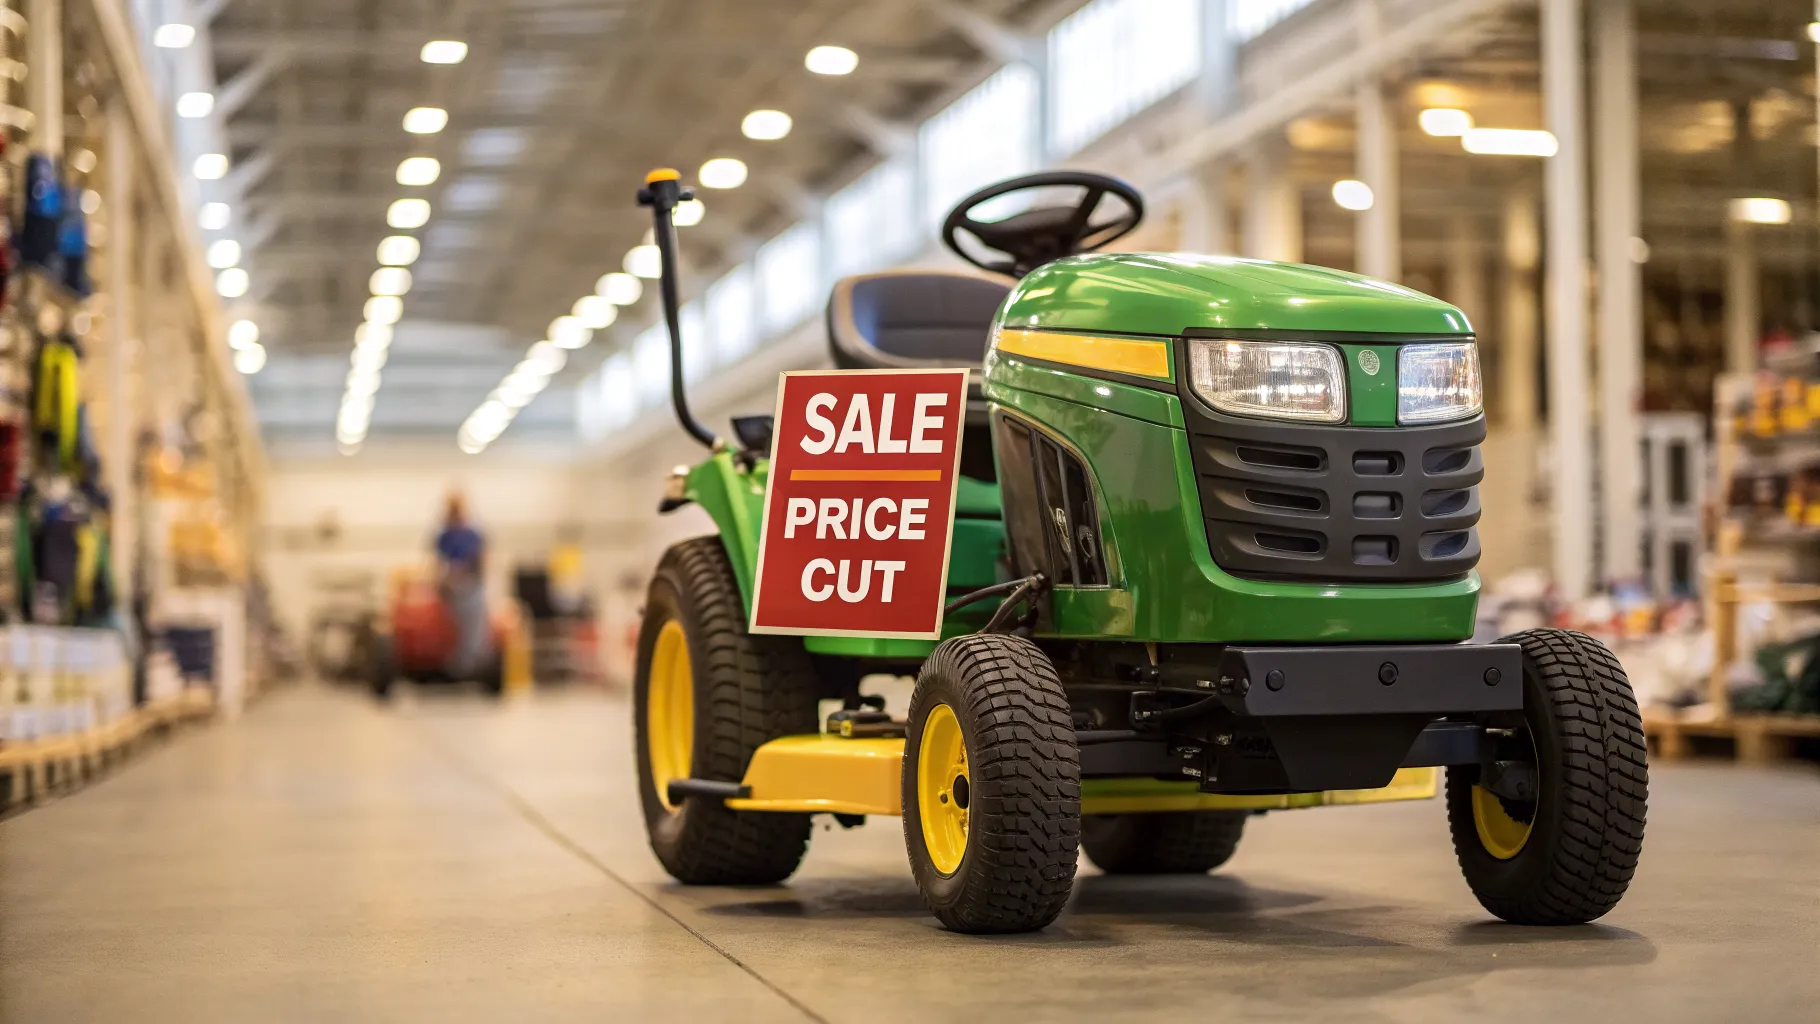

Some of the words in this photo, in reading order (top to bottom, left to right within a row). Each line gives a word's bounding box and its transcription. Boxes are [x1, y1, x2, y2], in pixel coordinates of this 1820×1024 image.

[800, 392, 949, 455] SALE
[783, 497, 930, 541] PRICE
[800, 557, 906, 603] CUT
